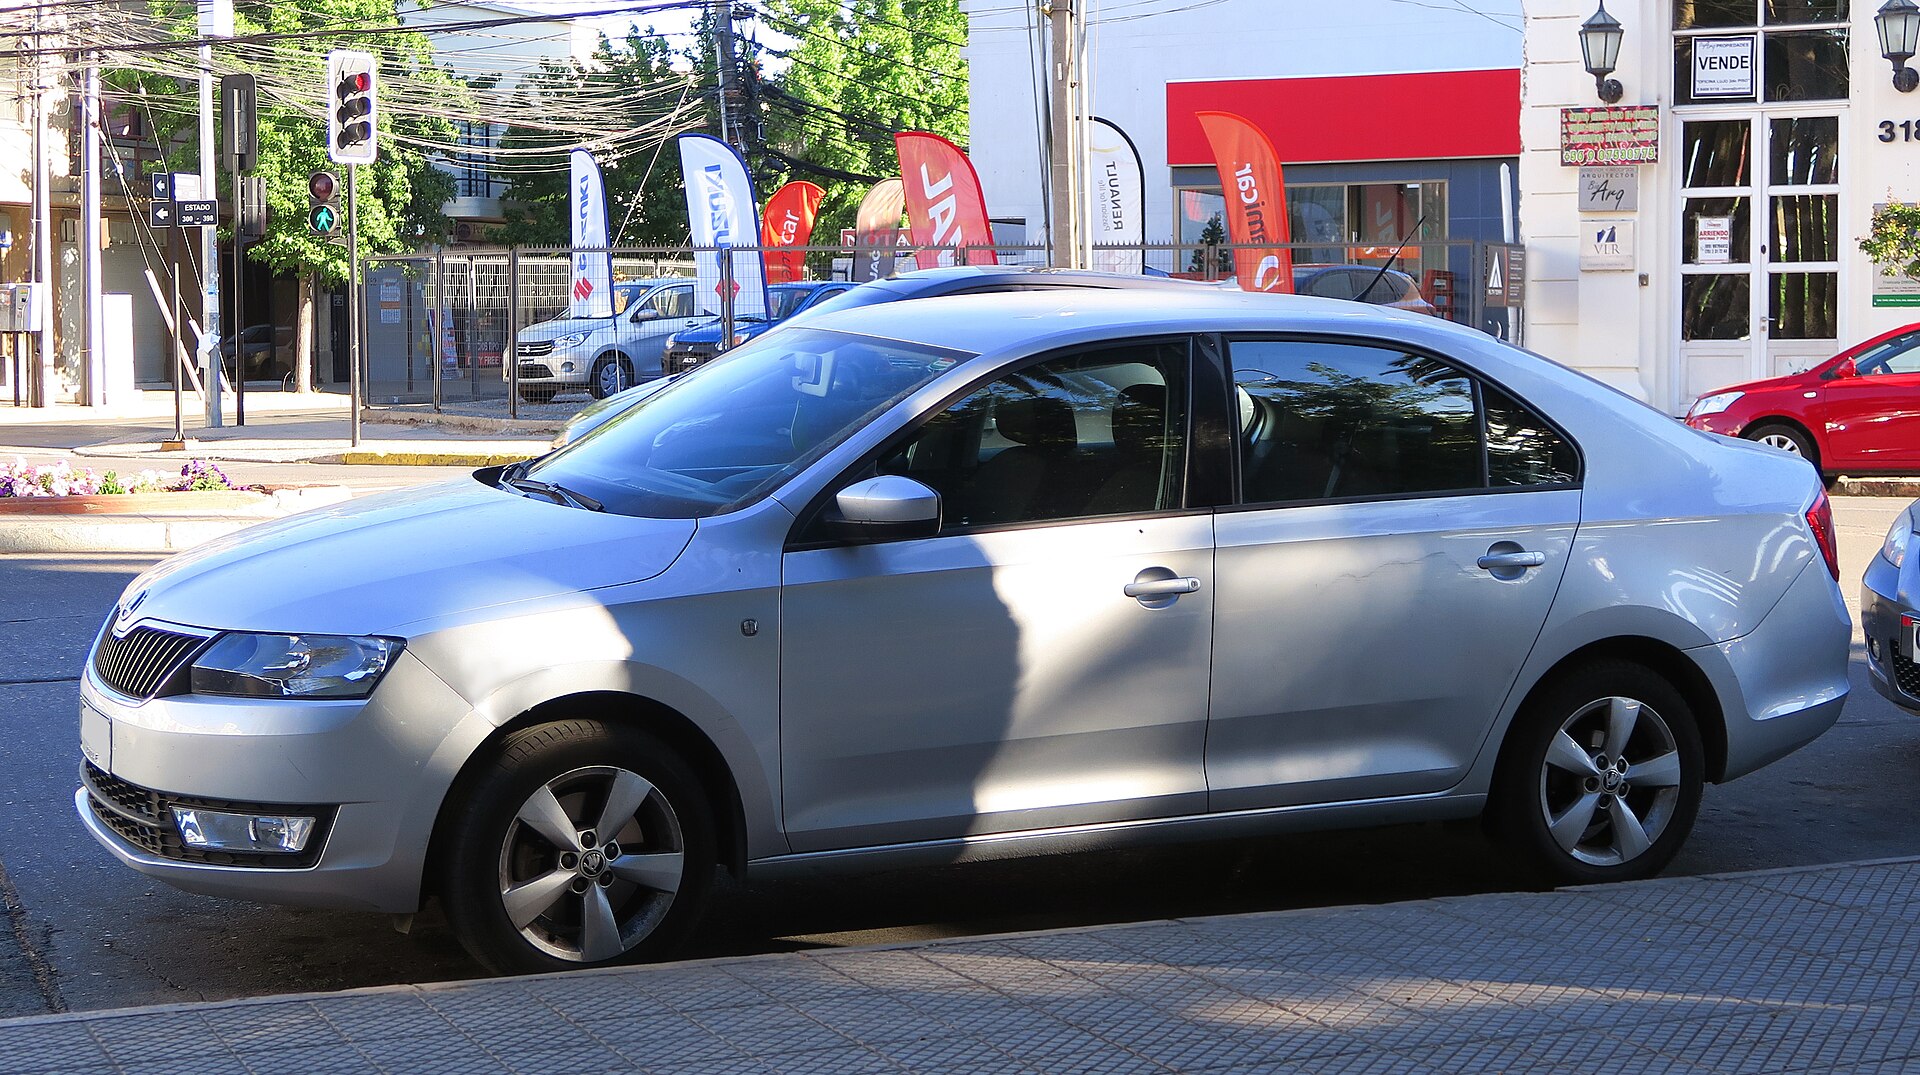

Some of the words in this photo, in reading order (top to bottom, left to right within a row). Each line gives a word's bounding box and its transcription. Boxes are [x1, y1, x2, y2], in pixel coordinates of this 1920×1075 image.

[1698, 55, 1749, 70] VENDE
[1587, 149, 1595, 161] 9
[781, 209, 800, 281] amcar
[485, 356, 499, 365] FREE
